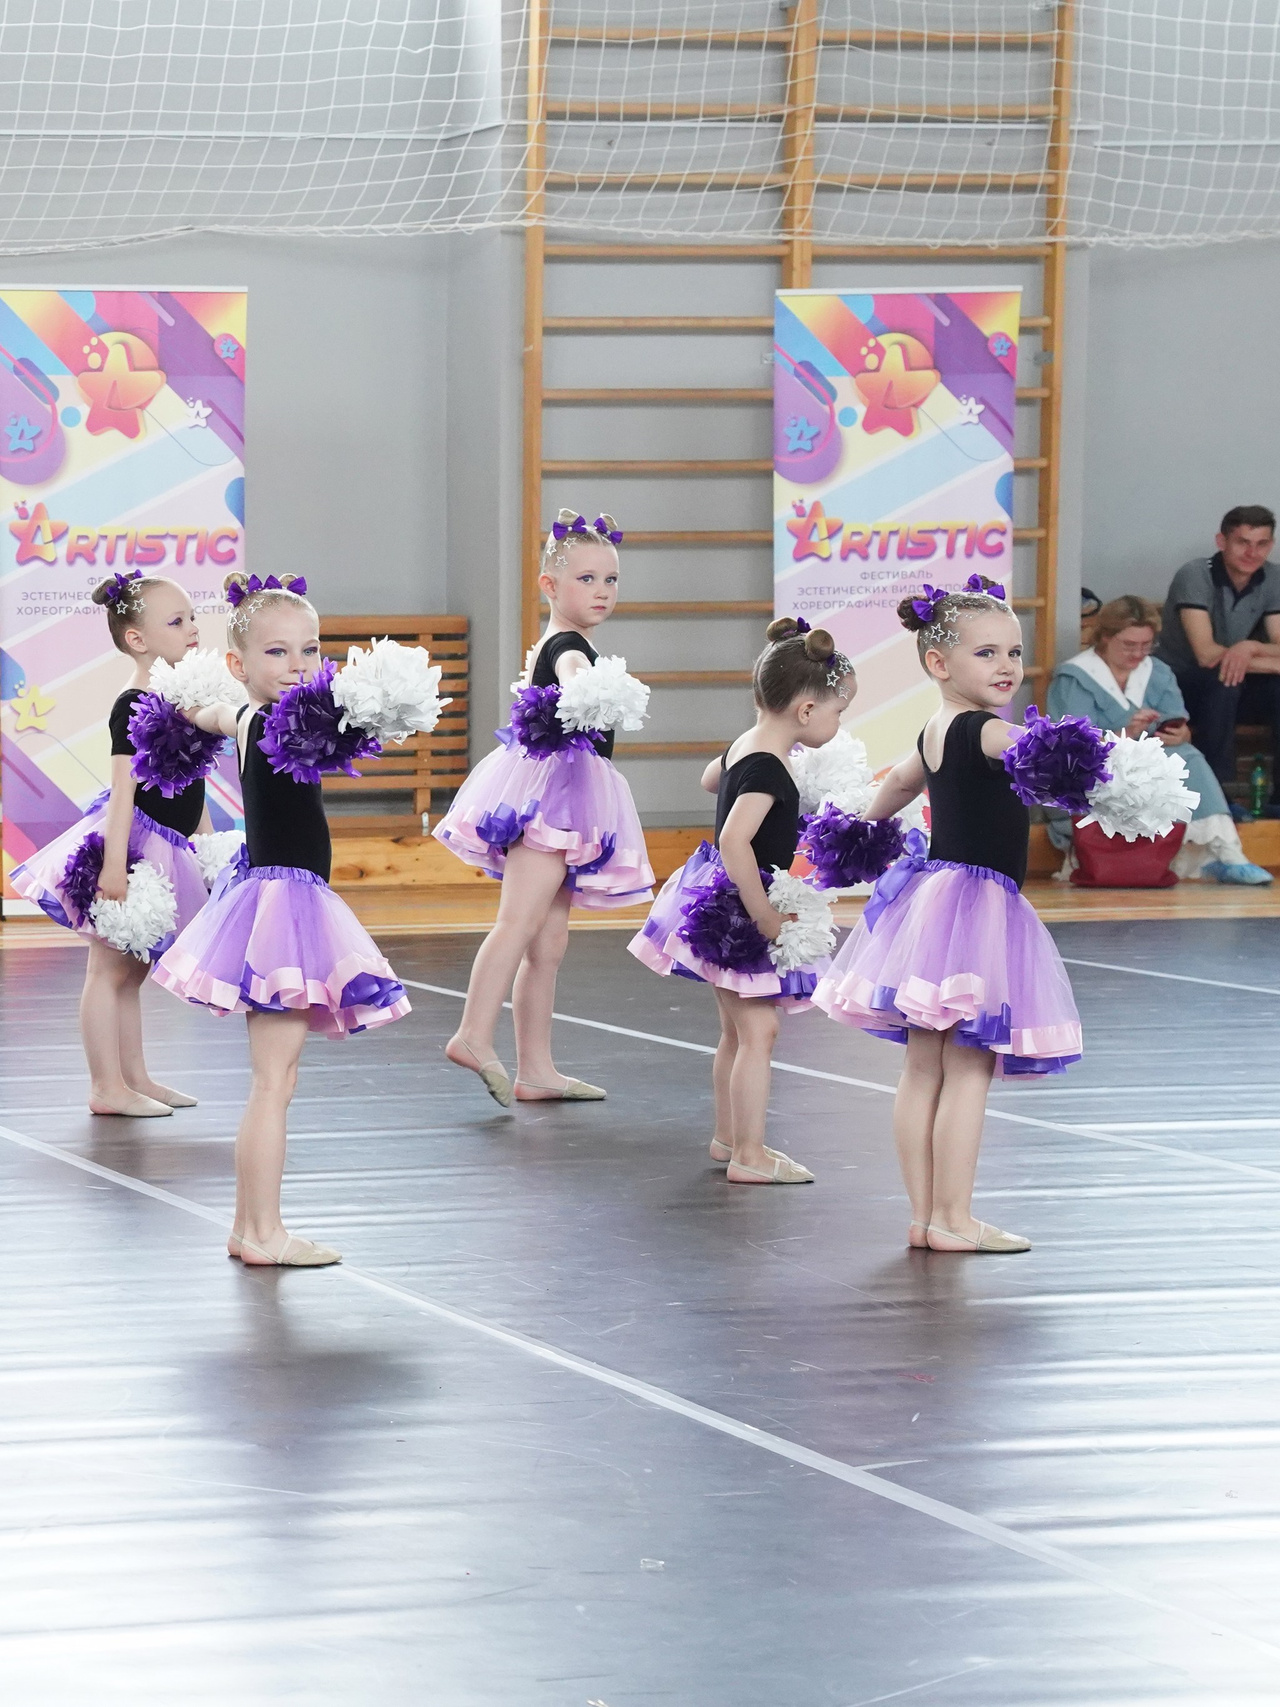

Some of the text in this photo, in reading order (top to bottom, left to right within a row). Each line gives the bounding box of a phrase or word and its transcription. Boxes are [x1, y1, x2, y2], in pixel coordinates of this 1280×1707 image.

[9, 502, 238, 565] ARTISTIC
[786, 500, 1007, 562] ARTISTIC
[859, 570, 933, 580] ФЕСТИВАЛЬ
[797, 583, 962, 596] ЭСТЕТИЧЕСКИХ ВИДО СПО
[21, 591, 91, 601] ЭСТЕТИЧЕС
[792, 599, 898, 610] ХОРЕОГРАФИЧЕС
